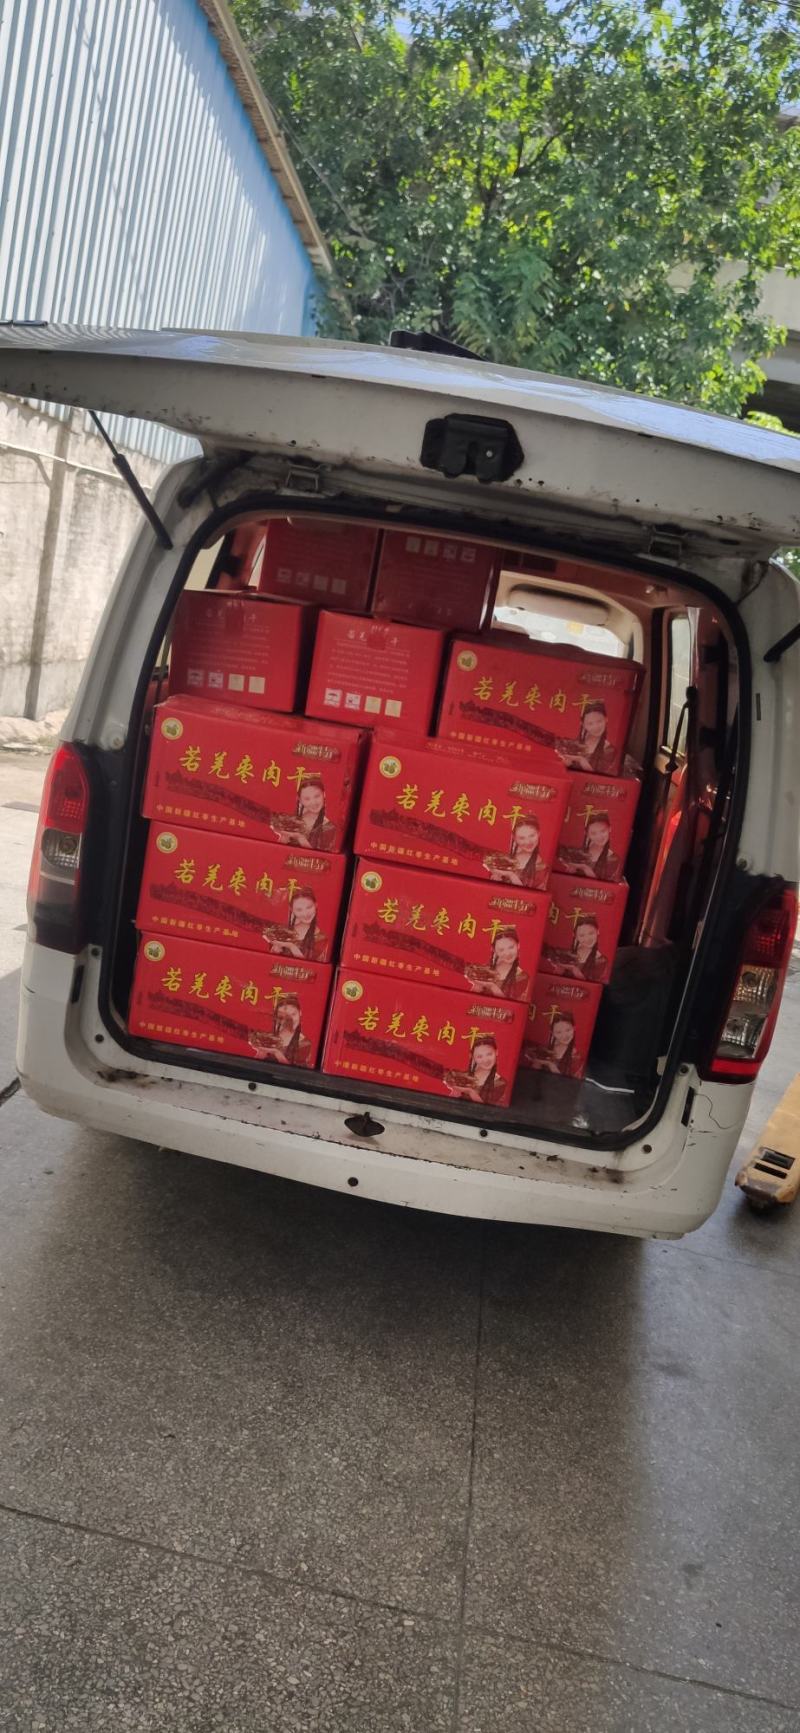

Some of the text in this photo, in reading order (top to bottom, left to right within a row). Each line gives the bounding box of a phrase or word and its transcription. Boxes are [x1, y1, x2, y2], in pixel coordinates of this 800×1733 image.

[473, 676, 602, 715] 若羌枣肉干
[179, 745, 317, 791] 若羌枣肉干
[396, 784, 528, 830] 若羌枣肉干
[174, 858, 302, 902] 若羌枣肉干
[377, 898, 513, 944] 若羌枣肉干
[161, 967, 294, 1009] 若羌枣肉干
[358, 1006, 491, 1049] 若羌枣肉干
